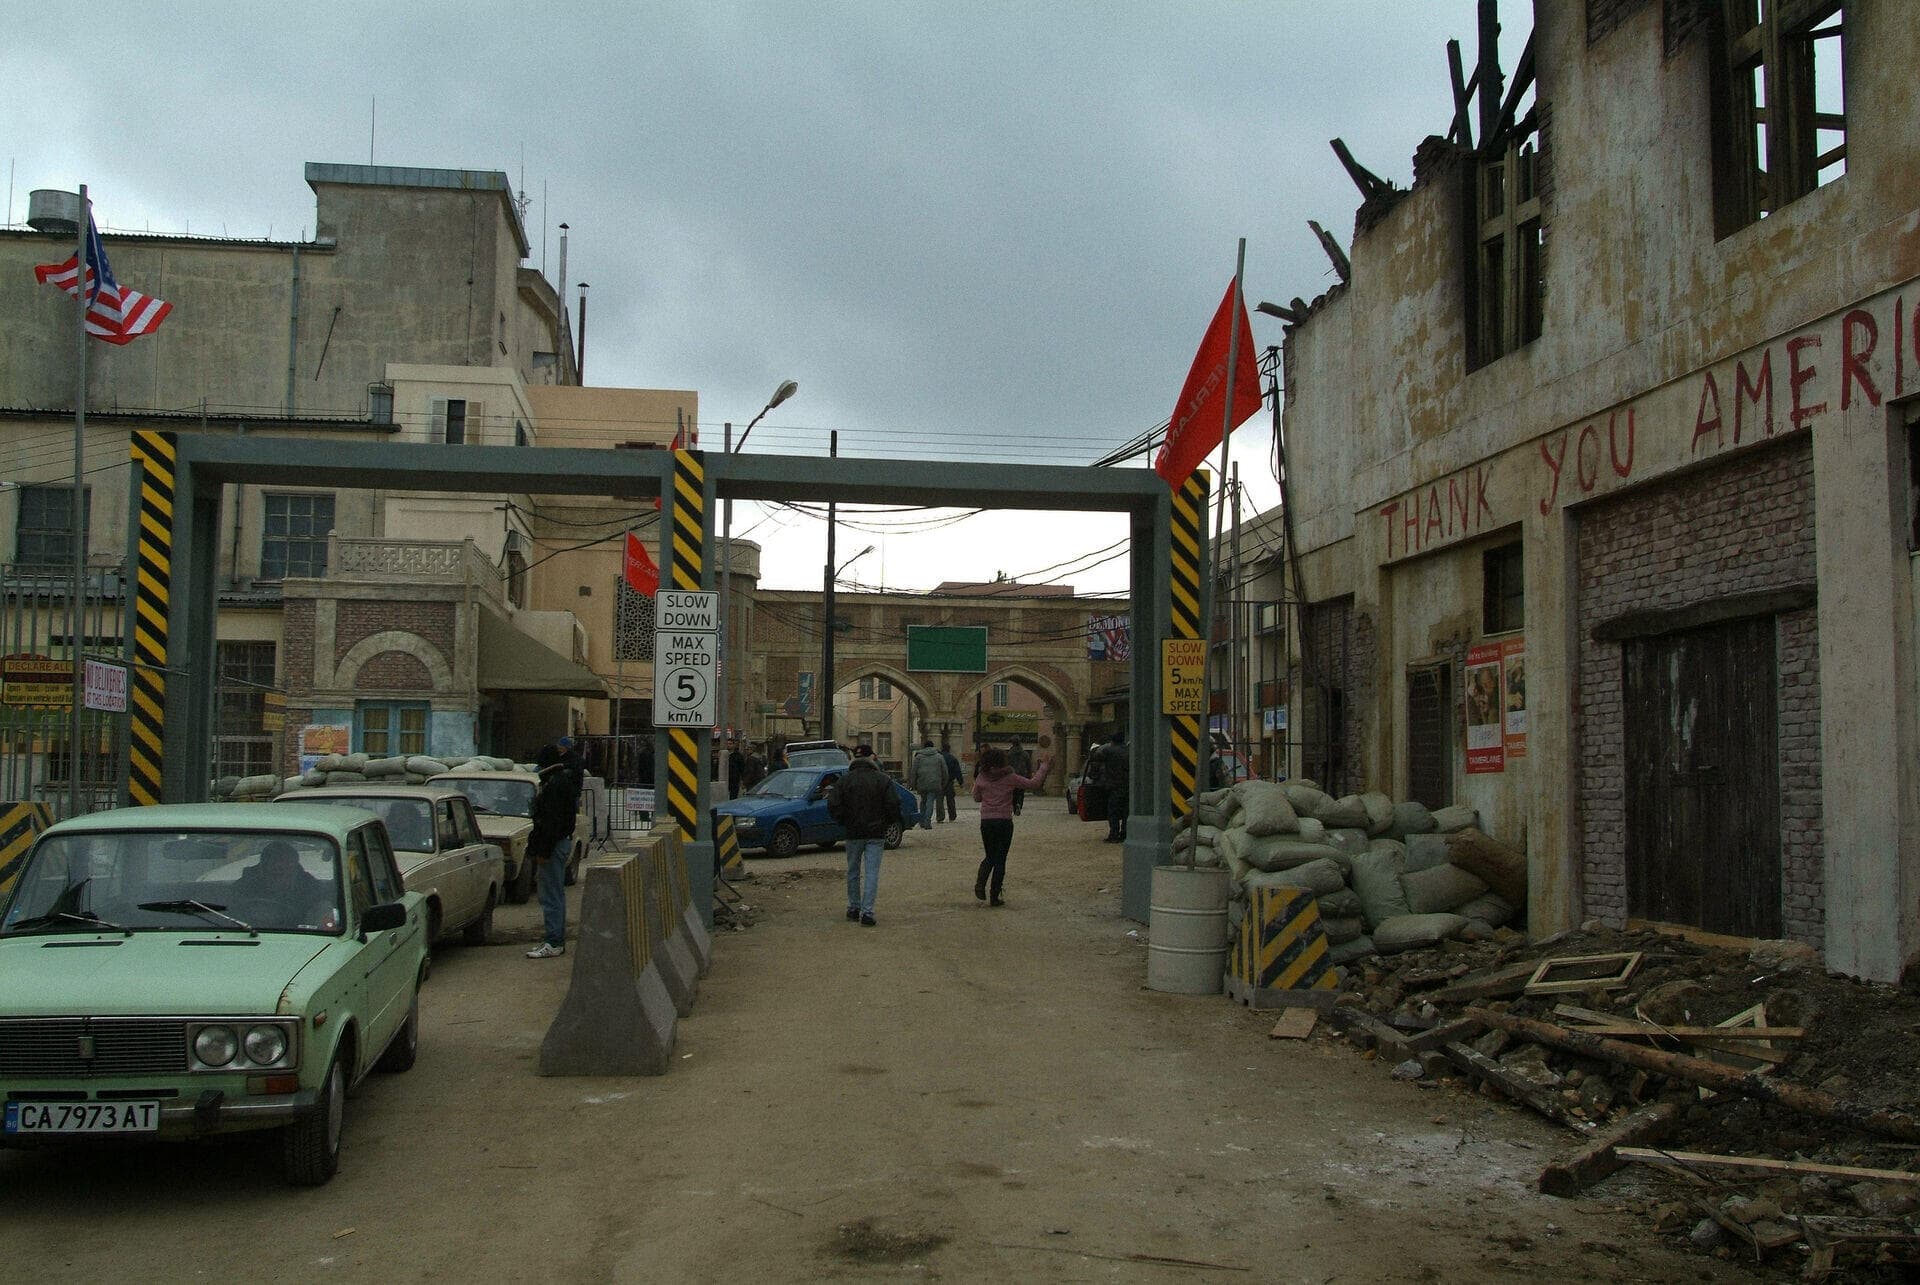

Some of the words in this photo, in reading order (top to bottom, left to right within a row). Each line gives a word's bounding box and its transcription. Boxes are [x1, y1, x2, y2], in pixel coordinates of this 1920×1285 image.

[1380, 463, 1495, 558] THANK
[1540, 408, 1635, 516] YOU
[666, 593, 709, 609] SLOW
[664, 612, 711, 627] DOWN
[672, 636, 704, 650] MAX
[1168, 642, 1202, 653] SLOW
[666, 652, 711, 666] SPEED
[1168, 655, 1204, 666] DOWN
[8, 662, 51, 671] DECLARE
[52, 662, 72, 671] ALL
[1172, 668, 1181, 685] 5
[677, 675, 696, 702] 5
[1174, 688, 1200, 698] MAX
[667, 709, 702, 723] km/h
[21, 1105, 52, 1129] CA
[57, 1105, 117, 1129] 7973
[122, 1104, 155, 1128] AT
